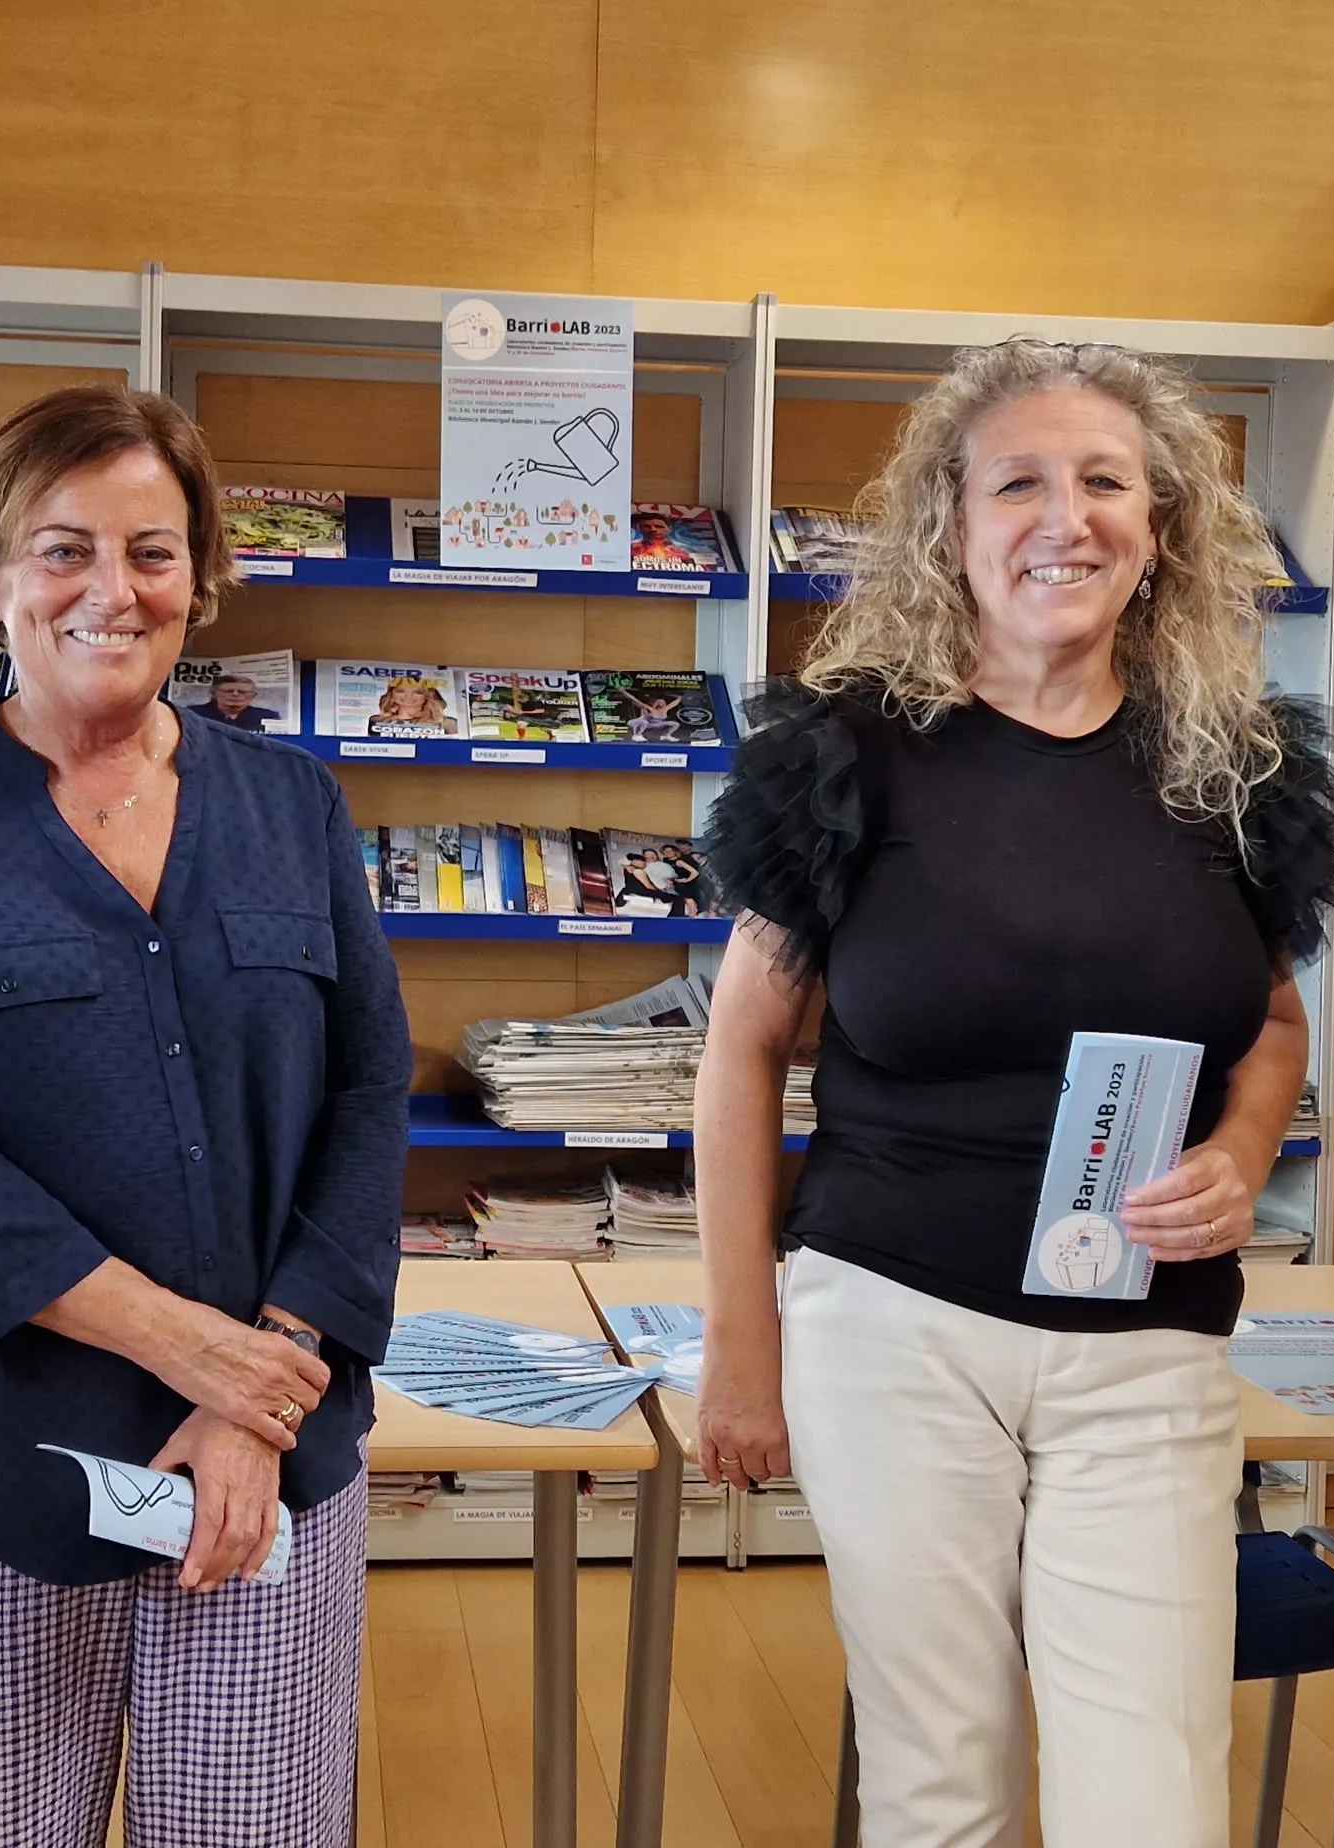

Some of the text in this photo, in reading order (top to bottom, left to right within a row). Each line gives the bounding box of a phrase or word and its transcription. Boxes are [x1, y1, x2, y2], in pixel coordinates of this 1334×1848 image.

[594, 325, 621, 335] 2023
[225, 486, 343, 504] COCINA
[392, 572, 401, 580] LA
[404, 572, 431, 581] MAGIA
[445, 574, 472, 582] VIAJAR
[340, 666, 423, 680] SABER
[174, 673, 215, 684] lee
[1107, 1062, 1126, 1100] 2023
[1181, 1055, 1200, 1117] CIUDADANOS
[568, 1136, 650, 1145] HERALDO DE ARAGÓN
[468, 1511, 494, 1519] MAGIA
[497, 1511, 507, 1519] DE
[779, 1509, 805, 1517] VANITY
